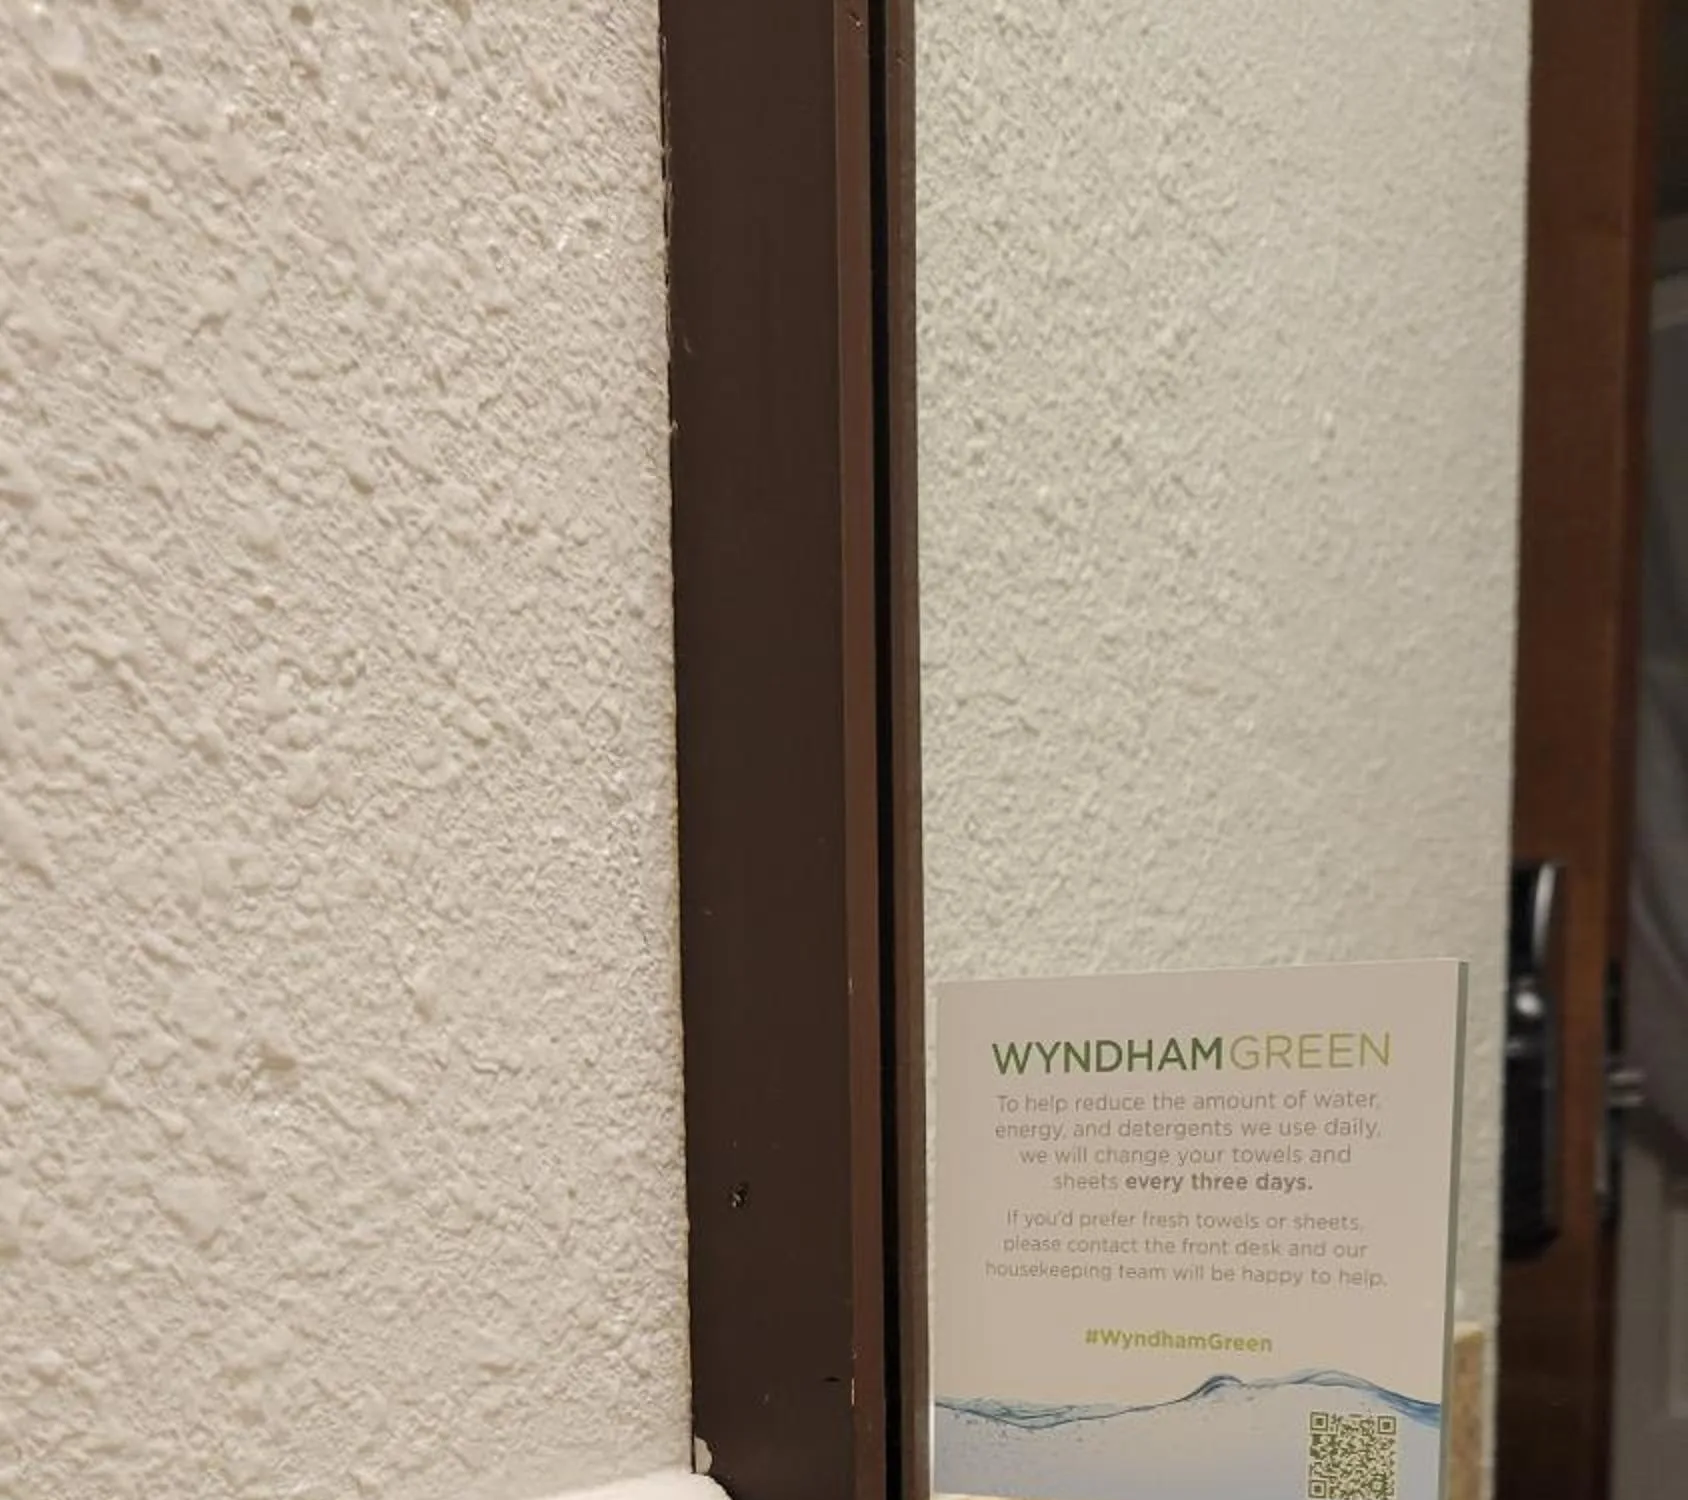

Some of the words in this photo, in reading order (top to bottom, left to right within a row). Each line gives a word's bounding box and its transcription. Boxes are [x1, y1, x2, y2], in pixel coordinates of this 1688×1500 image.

[996, 1095, 1019, 1113] To
[1024, 1093, 1069, 1114] help
[1075, 1093, 1146, 1112] reduce
[1152, 1091, 1186, 1111] the
[1193, 1092, 1276, 1110] amount
[1283, 1089, 1308, 1109] of
[1313, 1091, 1381, 1110] water,
[995, 1121, 1066, 1141] energy,
[1073, 1119, 1111, 1137] and
[1117, 1119, 1233, 1140] detergents
[1241, 1121, 1272, 1137] we
[1279, 1121, 1317, 1137] use
[1323, 1118, 1381, 1139] daily,
[1018, 1149, 1047, 1164] we
[1055, 1146, 1088, 1164] will
[1094, 1146, 1171, 1167] change
[1176, 1149, 1222, 1167] your
[1232, 1145, 1303, 1164] towels
[1309, 1144, 1351, 1164] and
[1052, 1172, 1119, 1190] sheets
[1125, 1173, 1184, 1193] every
[1191, 1171, 1249, 1191] three
[1255, 1171, 1314, 1194] days.
[1006, 1209, 1019, 1227] If
[1023, 1209, 1074, 1229] you'd
[1079, 1210, 1137, 1231] prefer
[1142, 1209, 1189, 1228] fresh
[1196, 1212, 1261, 1230] towels
[1265, 1215, 1288, 1230] or
[1003, 1234, 1061, 1253] please
[1067, 1237, 1138, 1254] contact
[1144, 1237, 1176, 1254] the
[1182, 1236, 1229, 1256] front
[1234, 1238, 1282, 1256] desk
[1287, 1240, 1327, 1258] and
[1332, 1243, 1369, 1259] our
[985, 1260, 1113, 1282] housekeeping
[1118, 1263, 1166, 1280] team
[1173, 1263, 1204, 1281] will
[1211, 1263, 1235, 1281] be
[1242, 1264, 1304, 1287] happy
[1310, 1267, 1332, 1286] to
[1339, 1268, 1388, 1289] help.
[1085, 1327, 1273, 1353] #WyndhamGreen
